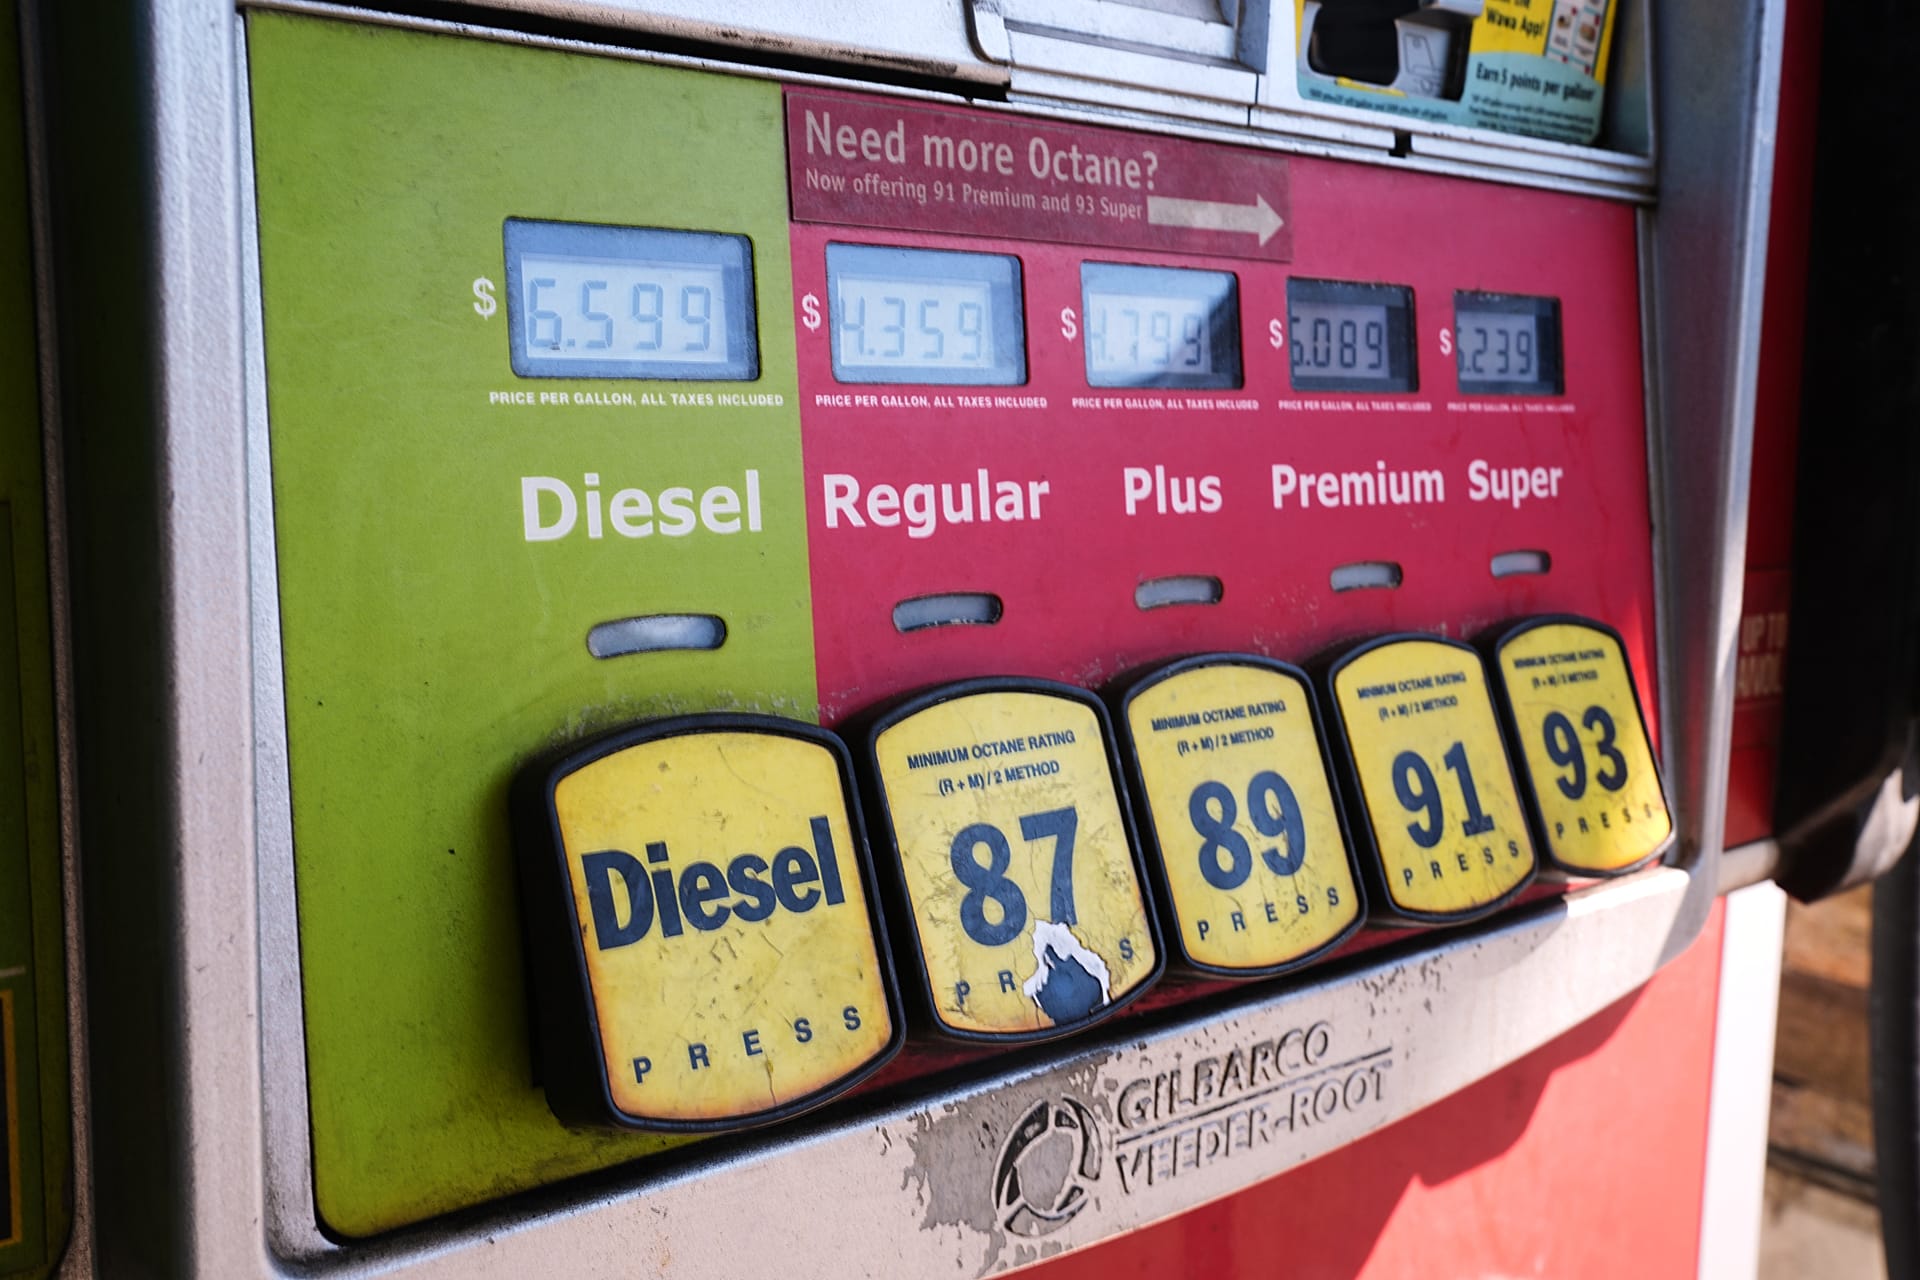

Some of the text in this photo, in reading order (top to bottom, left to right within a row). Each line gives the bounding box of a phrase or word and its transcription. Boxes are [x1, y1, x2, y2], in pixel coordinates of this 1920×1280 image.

[1486, 7, 1517, 31] Wawa
[1476, 62, 1499, 83] Earn
[1501, 67, 1508, 86] 5
[1509, 73, 1541, 92] points
[1543, 80, 1560, 96] per
[805, 109, 1158, 191] Need more Octane?
[806, 167, 1143, 223] Now offering 91 Premium and 93 Super
[472, 276, 711, 352] $ 6.599
[802, 292, 982, 361] $ 4.359
[1061, 307, 1077, 342] $
[1269, 318, 1283, 349] $
[1439, 328, 1452, 356] $
[489, 391, 784, 407] PRICE PER GALLON, ALL TAXES INCLUDED
[815, 394, 1048, 409] PRICE PER GALLON, ALL TAXES INCLUDED
[1072, 397, 1260, 411] PRICE PER GALLON, ALL TAXES INCLUDED
[1278, 399, 1302, 411] PRICE
[1304, 400, 1320, 411] PER
[1355, 400, 1370, 412] ALL
[520, 469, 762, 542] Diesel
[822, 468, 1050, 539] Regular
[1123, 465, 1223, 515] Plus
[1272, 460, 1445, 509] Premium
[1468, 459, 1563, 509] Super
[1357, 671, 1467, 699] MINIMUM OCTANE RATING
[1422, 695, 1458, 711] METHOD
[1151, 699, 1286, 731] MINIMUM OCTANE RATING
[907, 729, 1076, 769] MINIMUM OCTANE RATING
[1177, 726, 1274, 757] (R + M) / 2 METHOD
[1543, 705, 1628, 801] 93
[939, 760, 1060, 797] (R + M) / 2 METHOD
[1392, 741, 1495, 849] 91
[1188, 770, 1306, 890] 89
[1555, 802, 1653, 839] PRESS
[581, 815, 845, 951] Diesel
[950, 805, 1079, 947] 87
[1403, 840, 1520, 886] PRESS
[1197, 886, 1340, 941] PRESS
[955, 937, 1134, 1005] PRS
[633, 1005, 862, 1084] PRESS
[1117, 1019, 1335, 1130] GILBARCO
[1115, 1059, 1393, 1194] VEEDER-ROOT
